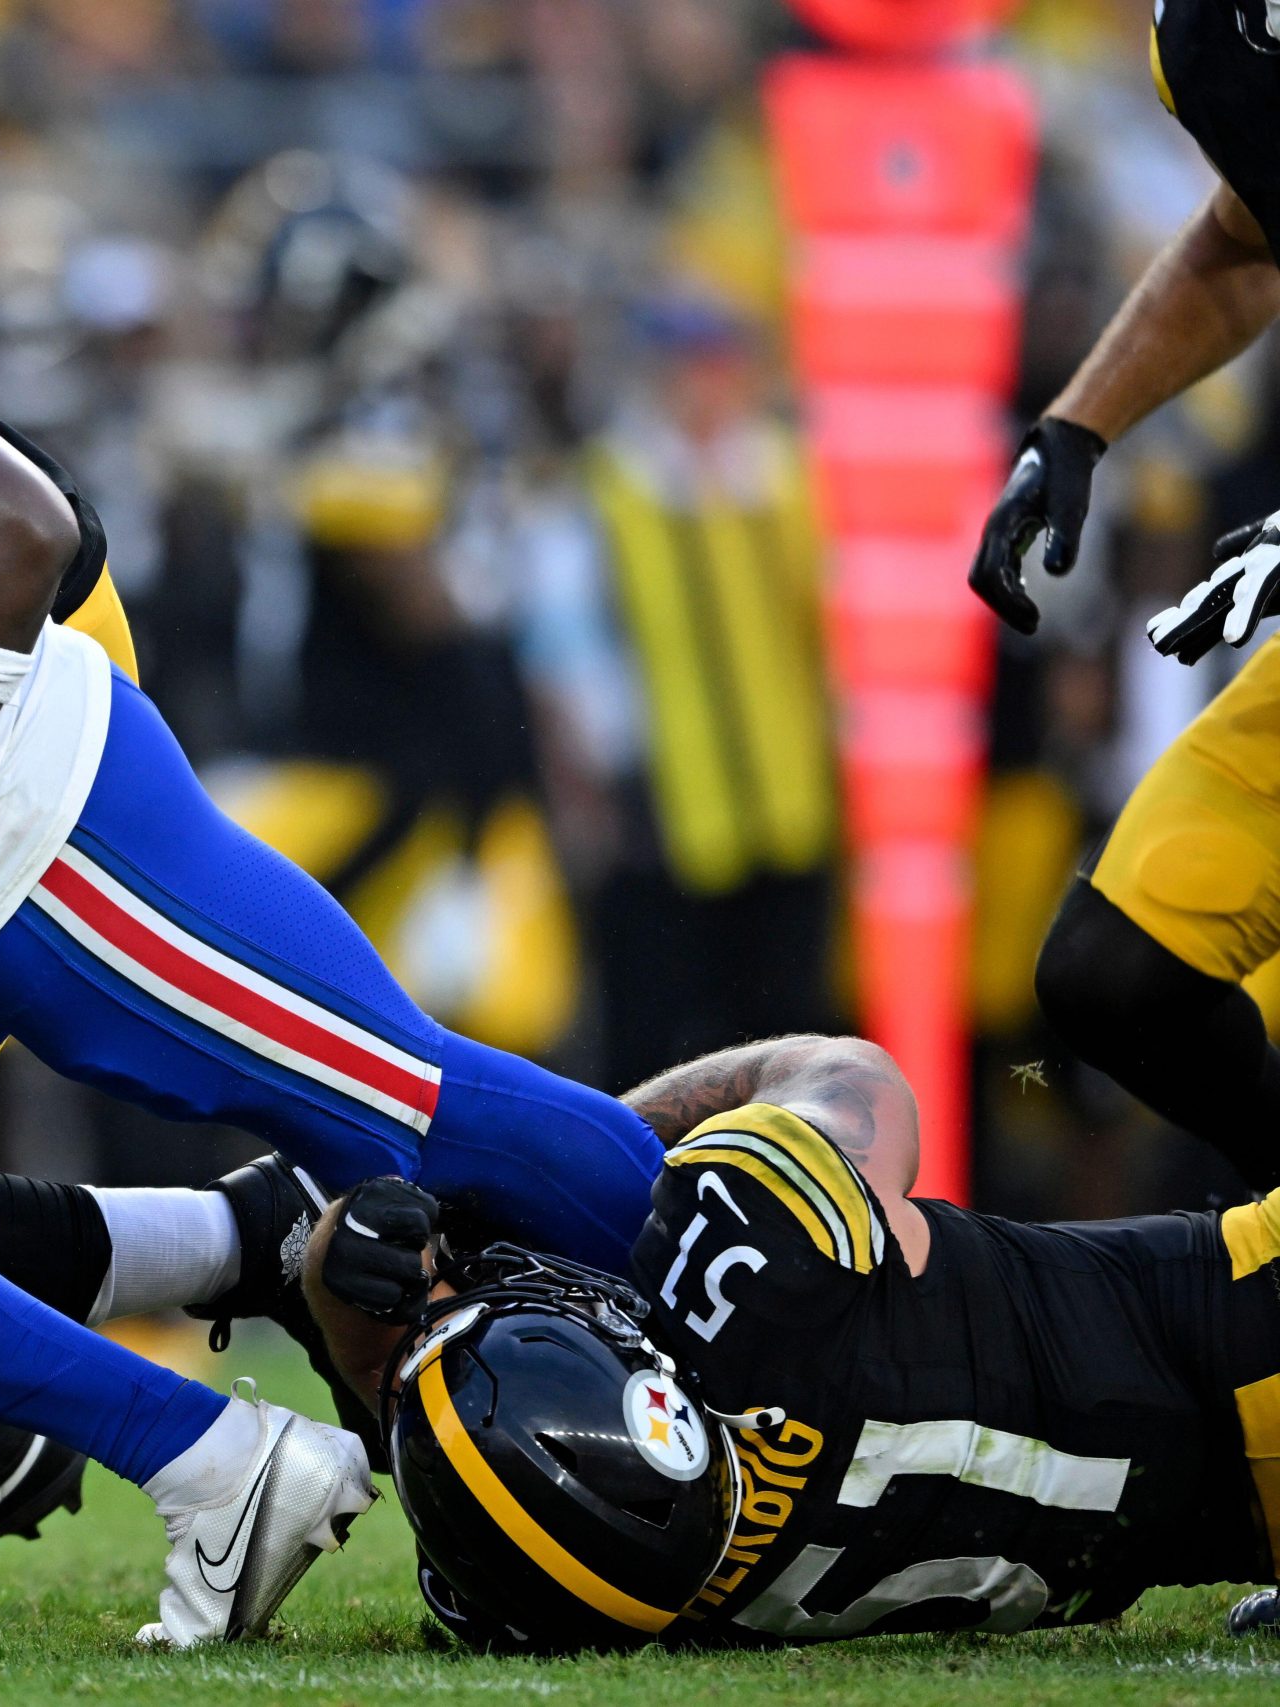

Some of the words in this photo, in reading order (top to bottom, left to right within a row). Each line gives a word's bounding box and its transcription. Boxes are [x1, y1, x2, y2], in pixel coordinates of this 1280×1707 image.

[281, 1225, 300, 1256] JORDAN
[659, 1211, 769, 1344] 51
[673, 1425, 695, 1462] Steelers
[730, 1418, 1132, 1638] 51
